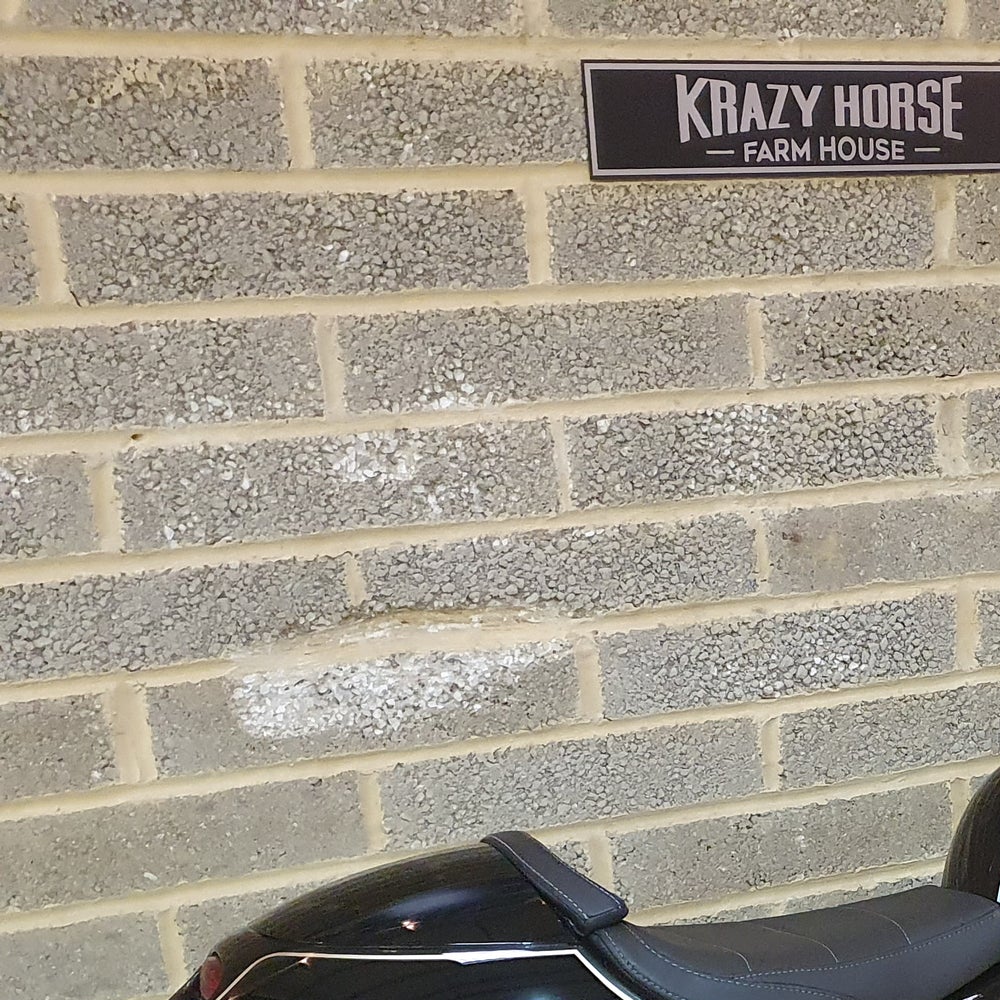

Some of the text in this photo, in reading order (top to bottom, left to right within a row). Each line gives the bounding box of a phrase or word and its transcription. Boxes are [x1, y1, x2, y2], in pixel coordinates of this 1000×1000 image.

[675, 73, 963, 143] KRAZY HORSE
[744, 135, 905, 162] FARM HOUSE
